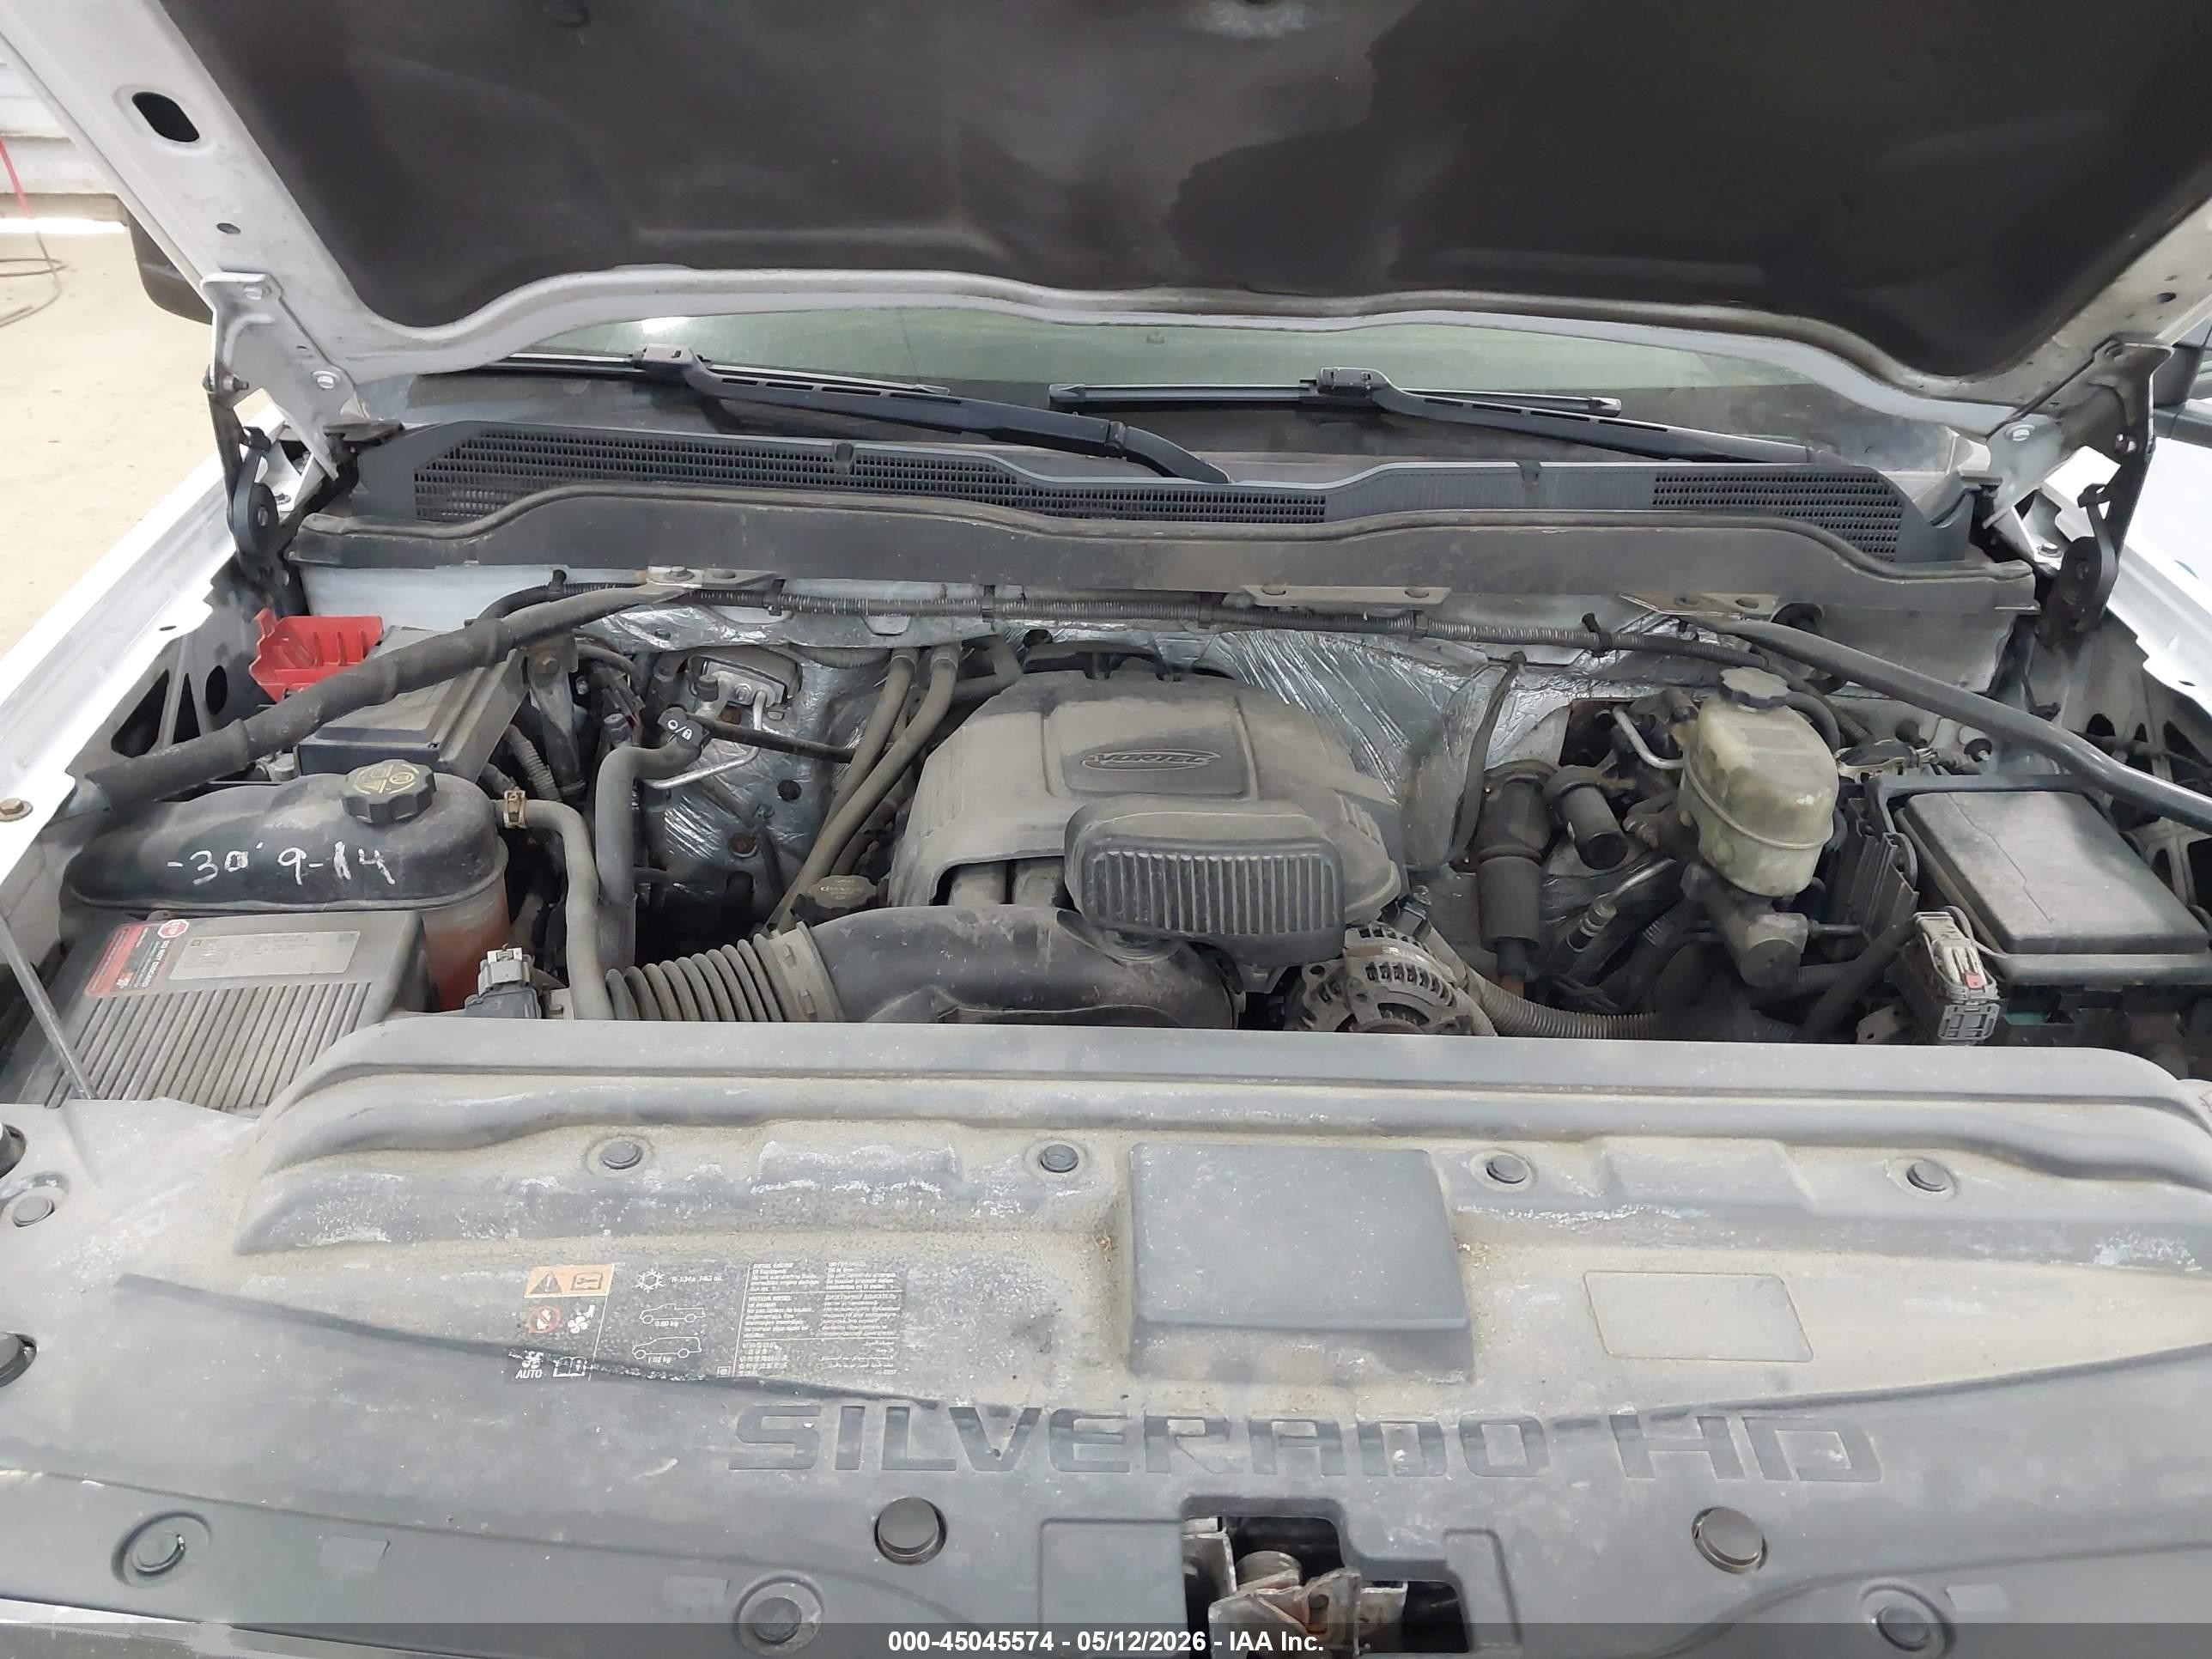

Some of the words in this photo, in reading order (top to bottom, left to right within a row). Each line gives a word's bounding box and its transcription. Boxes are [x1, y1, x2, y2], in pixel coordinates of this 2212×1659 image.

[515, 1369, 543, 1379] AUTO
[727, 1403, 1551, 1478] SILVERADO
[1608, 1413, 1883, 1483] HD
